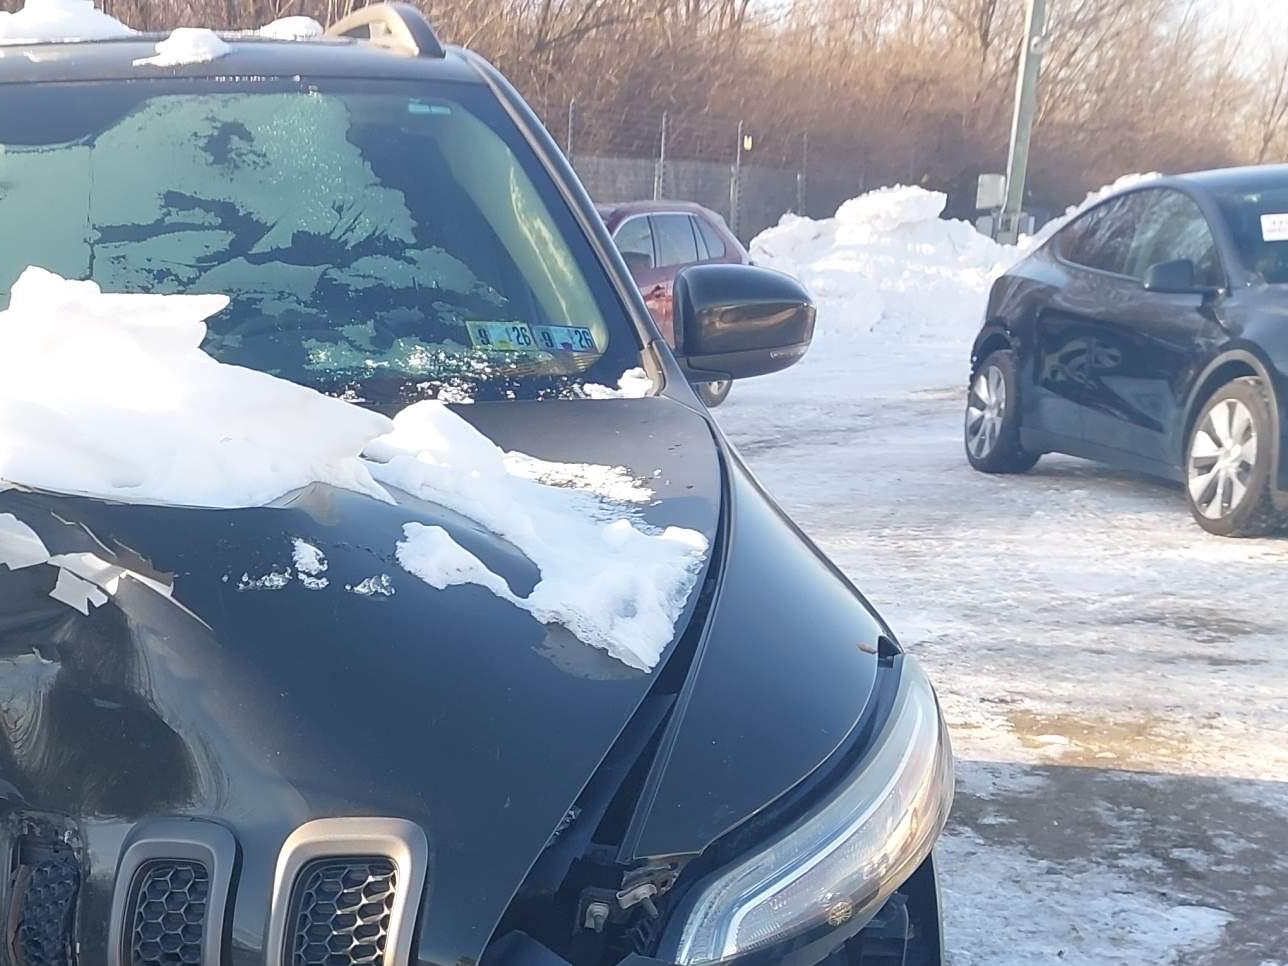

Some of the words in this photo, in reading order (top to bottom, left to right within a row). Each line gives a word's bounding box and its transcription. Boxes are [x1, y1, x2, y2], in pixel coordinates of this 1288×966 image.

[477, 328, 490, 346] 9
[511, 326, 532, 347] 26
[541, 331, 554, 348] 9
[574, 330, 594, 349] 26
